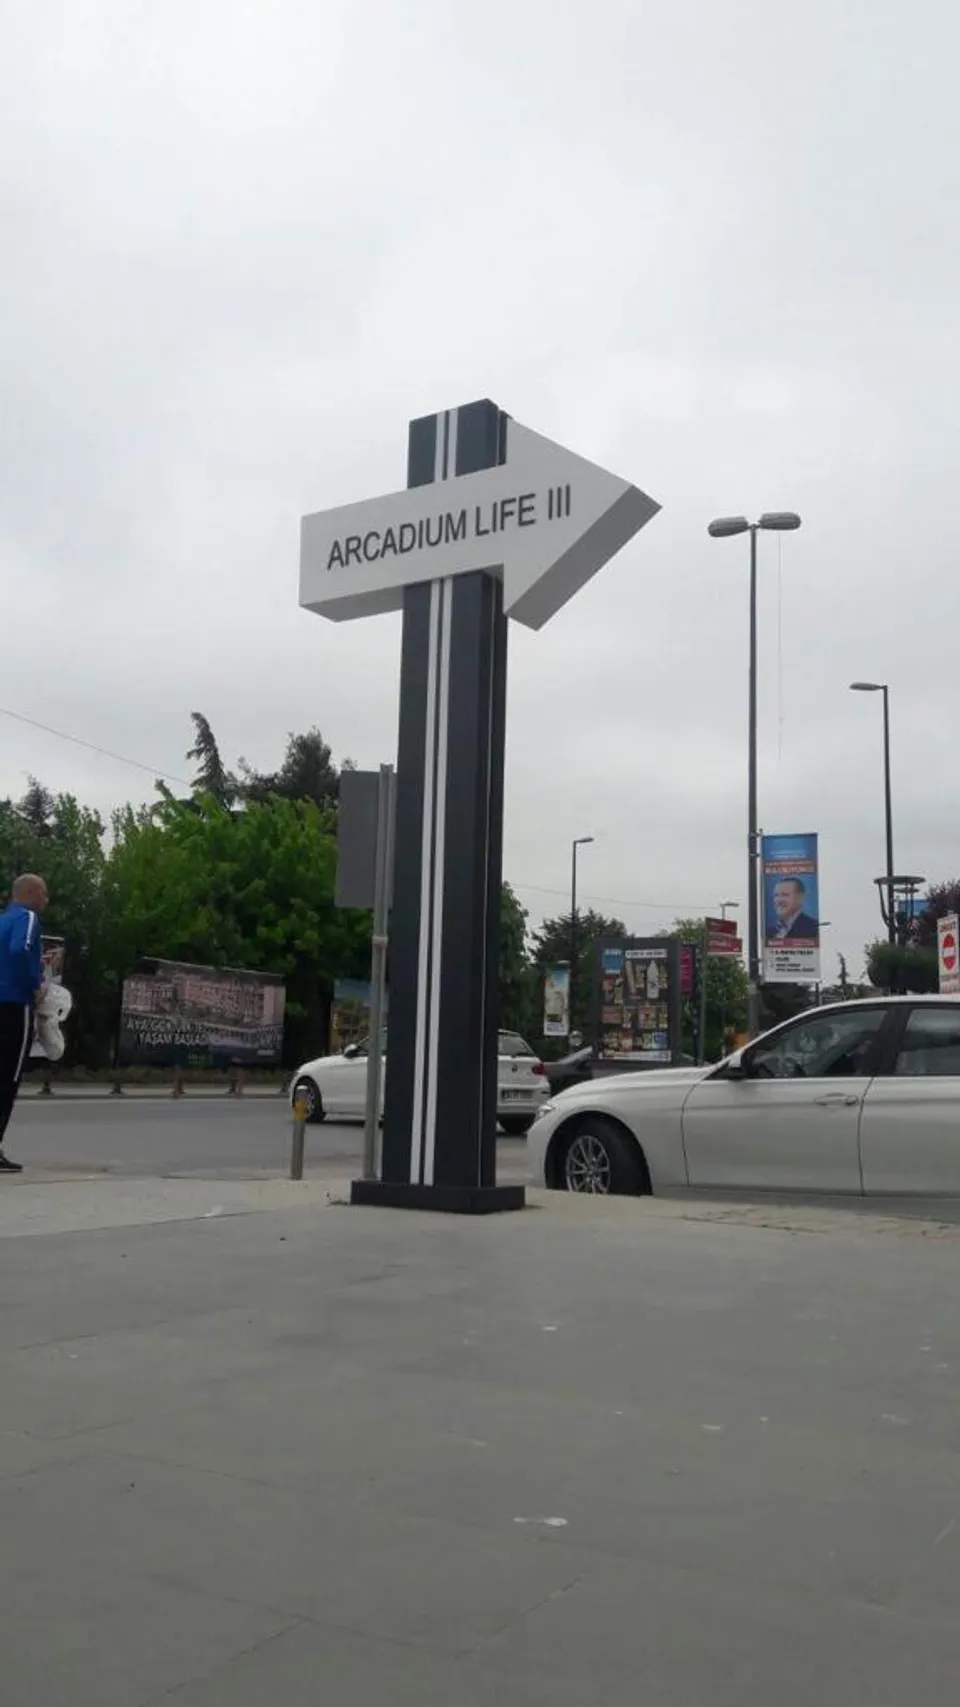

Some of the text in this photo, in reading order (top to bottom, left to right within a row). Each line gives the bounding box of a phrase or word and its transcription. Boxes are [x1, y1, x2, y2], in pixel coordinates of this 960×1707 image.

[327, 484, 571, 570] ARCADIUM LIFE III
